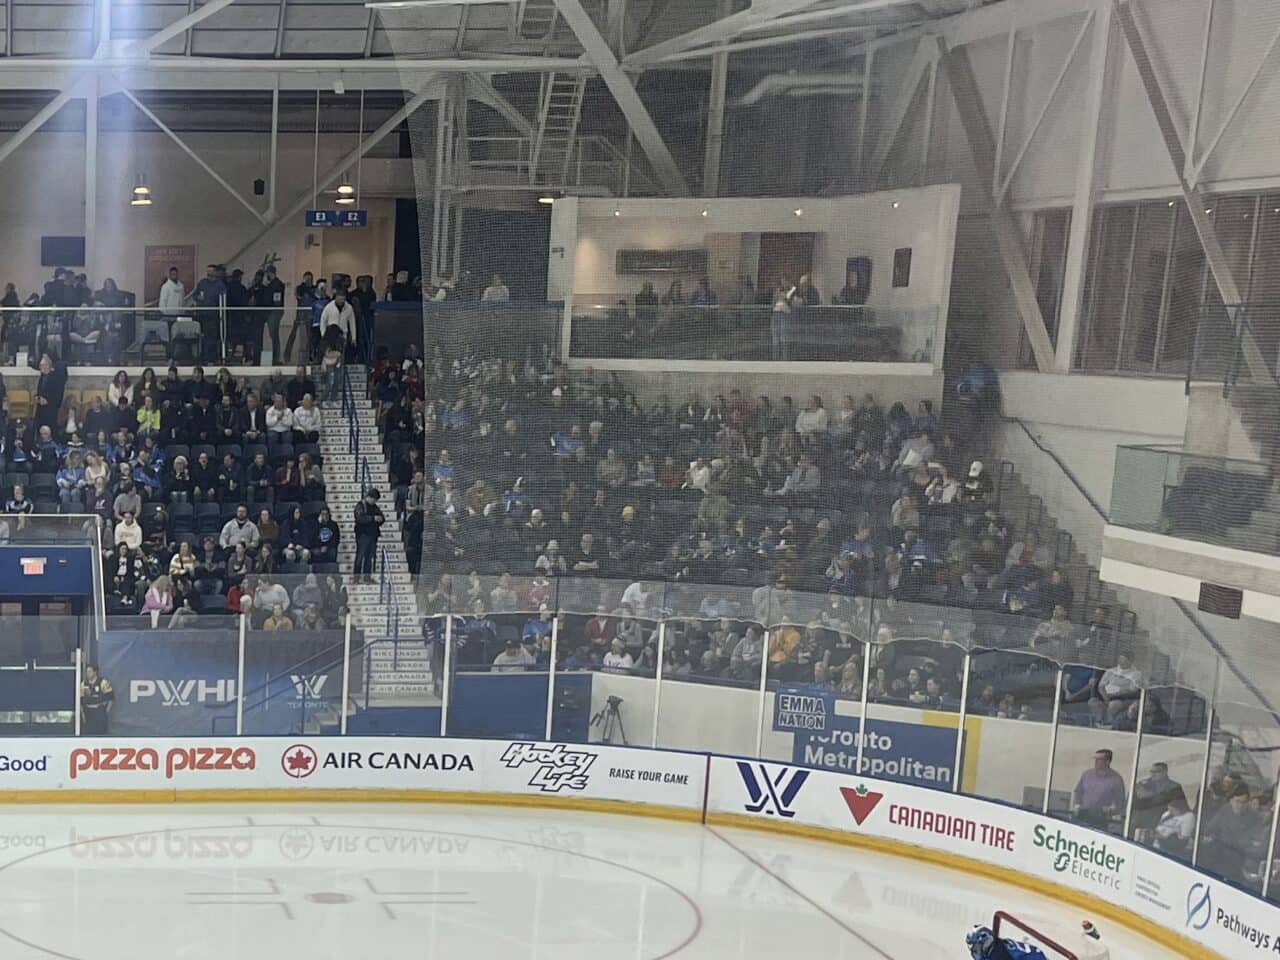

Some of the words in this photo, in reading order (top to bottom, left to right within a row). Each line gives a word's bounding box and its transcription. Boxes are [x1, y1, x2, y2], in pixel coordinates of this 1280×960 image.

[779, 694, 826, 715] EMMA
[778, 712, 826, 730] NATION
[70, 747, 159, 779] pizza
[166, 747, 256, 779] pizza
[322, 752, 363, 770] AIR
[368, 751, 474, 772] CANADA
[609, 767, 635, 780] RAISE
[638, 770, 662, 783] YOUR
[664, 772, 689, 785] GAME
[889, 804, 978, 841] CANADIAN
[980, 823, 1016, 851] TIRE
[1033, 824, 1125, 872] Schneider
[1071, 860, 1121, 890] Electric
[1216, 907, 1270, 949] Pathways
